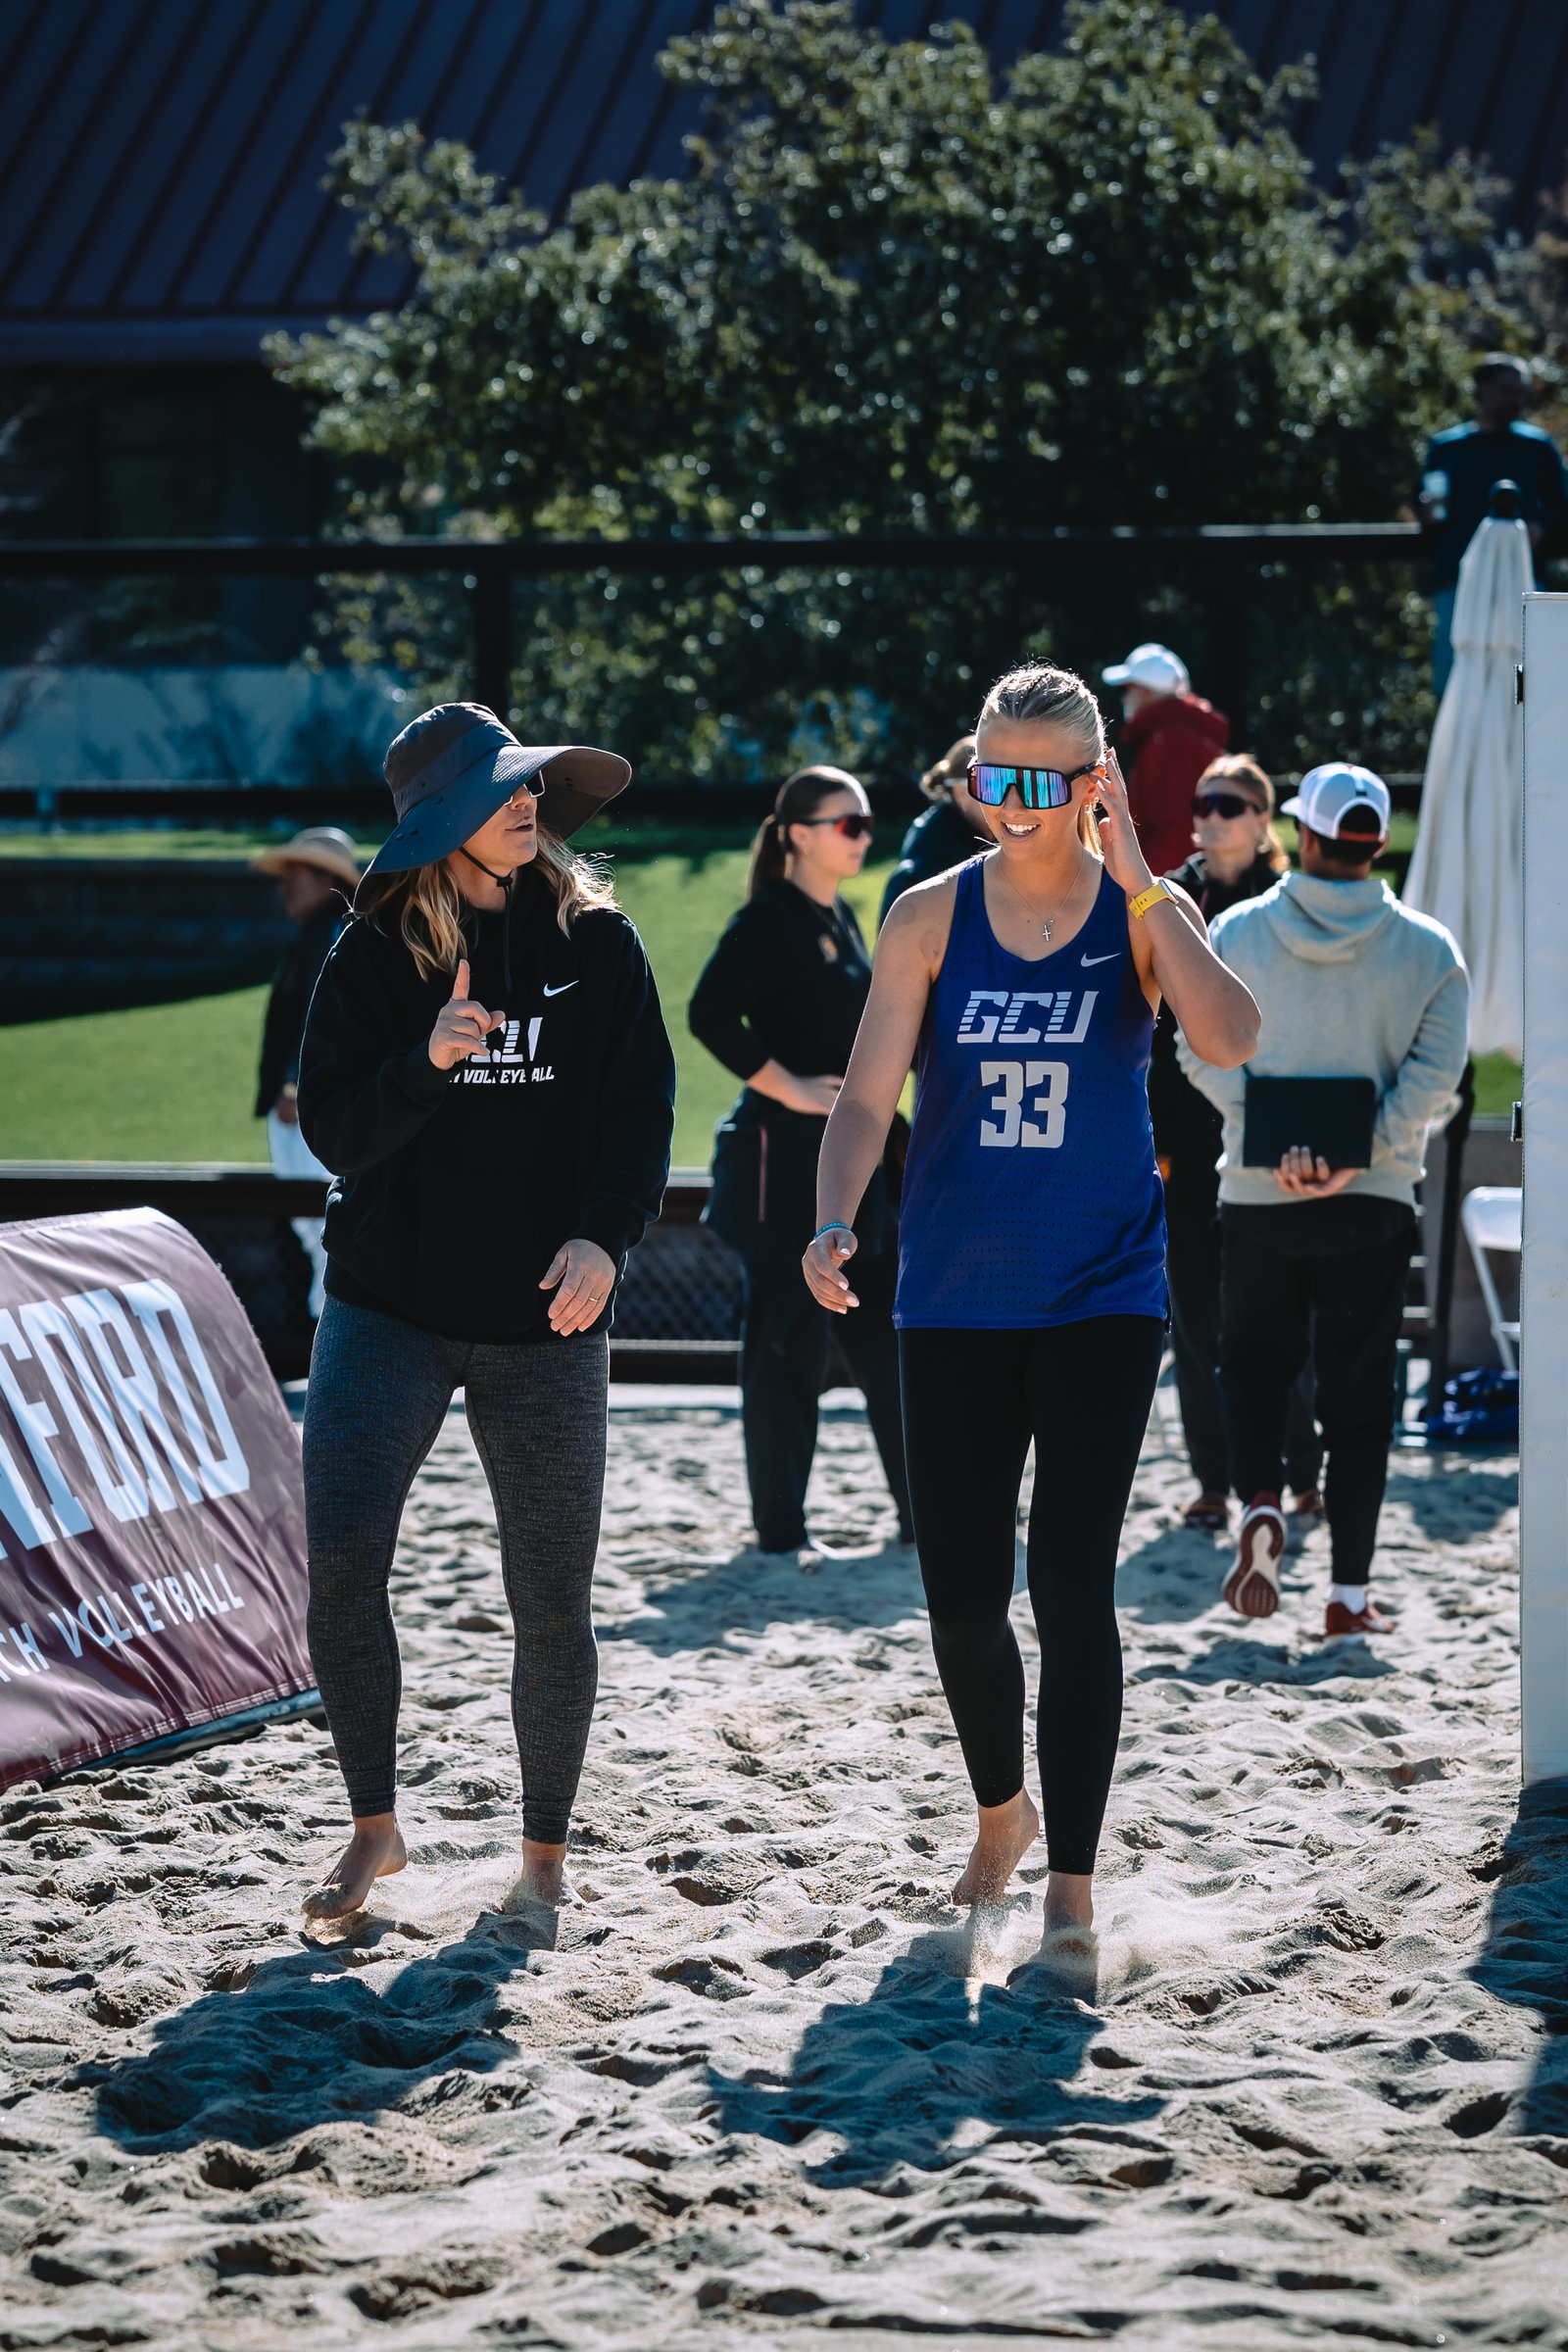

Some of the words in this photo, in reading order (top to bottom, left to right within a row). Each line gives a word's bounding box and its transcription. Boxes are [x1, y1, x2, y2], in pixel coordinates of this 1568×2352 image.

[956, 991, 1100, 1044] GCU
[980, 1061, 1069, 1149] 33
[48, 1563, 244, 1658] VOLLEYBALL
